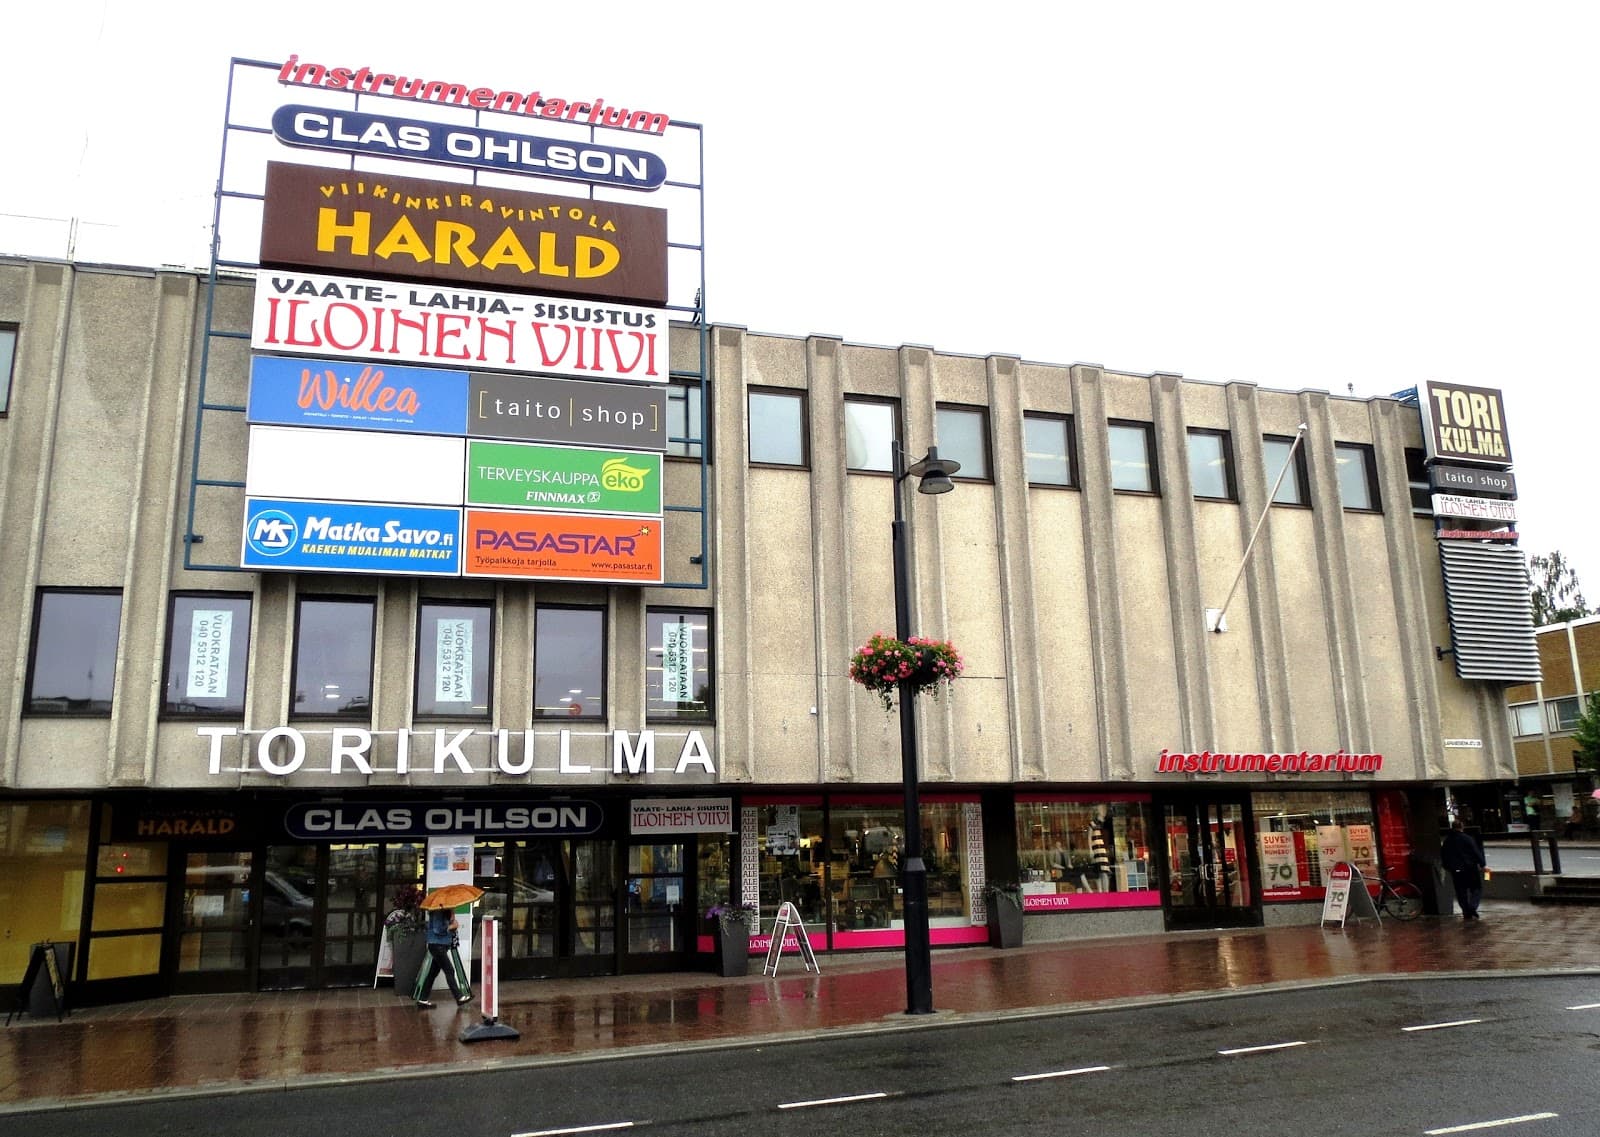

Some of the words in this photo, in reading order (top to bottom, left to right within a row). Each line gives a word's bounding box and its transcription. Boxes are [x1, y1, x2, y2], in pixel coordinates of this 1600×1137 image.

[277, 54, 670, 136] instrumentarium
[294, 112, 430, 152] CLAS
[447, 132, 648, 180] OHLSON
[320, 182, 616, 232] VIIKINKIRAVINTOLA
[316, 207, 621, 279] HARALD
[272, 277, 398, 303] VAATE-
[409, 290, 524, 315] LAHJA-
[534, 303, 656, 329] SISUSTUS
[264, 297, 516, 364] ILOINEN
[531, 321, 659, 376] VIIVI
[297, 366, 421, 416] Willea
[495, 398, 561, 420] taito
[582, 404, 644, 430] shop
[1431, 388, 1502, 432] TORI
[1439, 426, 1506, 458] KULMA
[477, 466, 600, 487] TERVEYSKAUPPA
[605, 472, 640, 489] eko
[1445, 472, 1473, 484] taito
[1480, 475, 1508, 489] shop
[526, 491, 585, 504] FINNMAX
[302, 544, 345, 556] KAEKEN
[348, 546, 406, 558] MUALIMAN
[409, 548, 452, 560] MATKAT
[476, 529, 636, 557] PASASTAR
[476, 556, 525, 567] Työpaikkoja
[527, 558, 556, 568] tarjolla
[592, 562, 652, 570] www.pasastar.fi
[198, 620, 208, 638] 040
[443, 628, 452, 646] 040
[196, 642, 208, 666] 5312
[208, 614, 223, 694] VUOKRATAAN
[442, 649, 452, 672] 5312
[454, 623, 464, 698] VUOKRATAAN
[680, 627, 688, 698] VUOKRATAAN
[194, 670, 204, 687] 120
[442, 675, 451, 692] 120
[668, 677, 676, 692] 120
[197, 726, 716, 775] TORIKULMA
[1157, 748, 1383, 773] instrumentarium
[138, 818, 235, 836] HARALD
[304, 808, 412, 832] CLAS
[425, 806, 587, 830] OHLSON
[633, 812, 694, 827] ILOINEN
[697, 812, 730, 825] VIIVI
